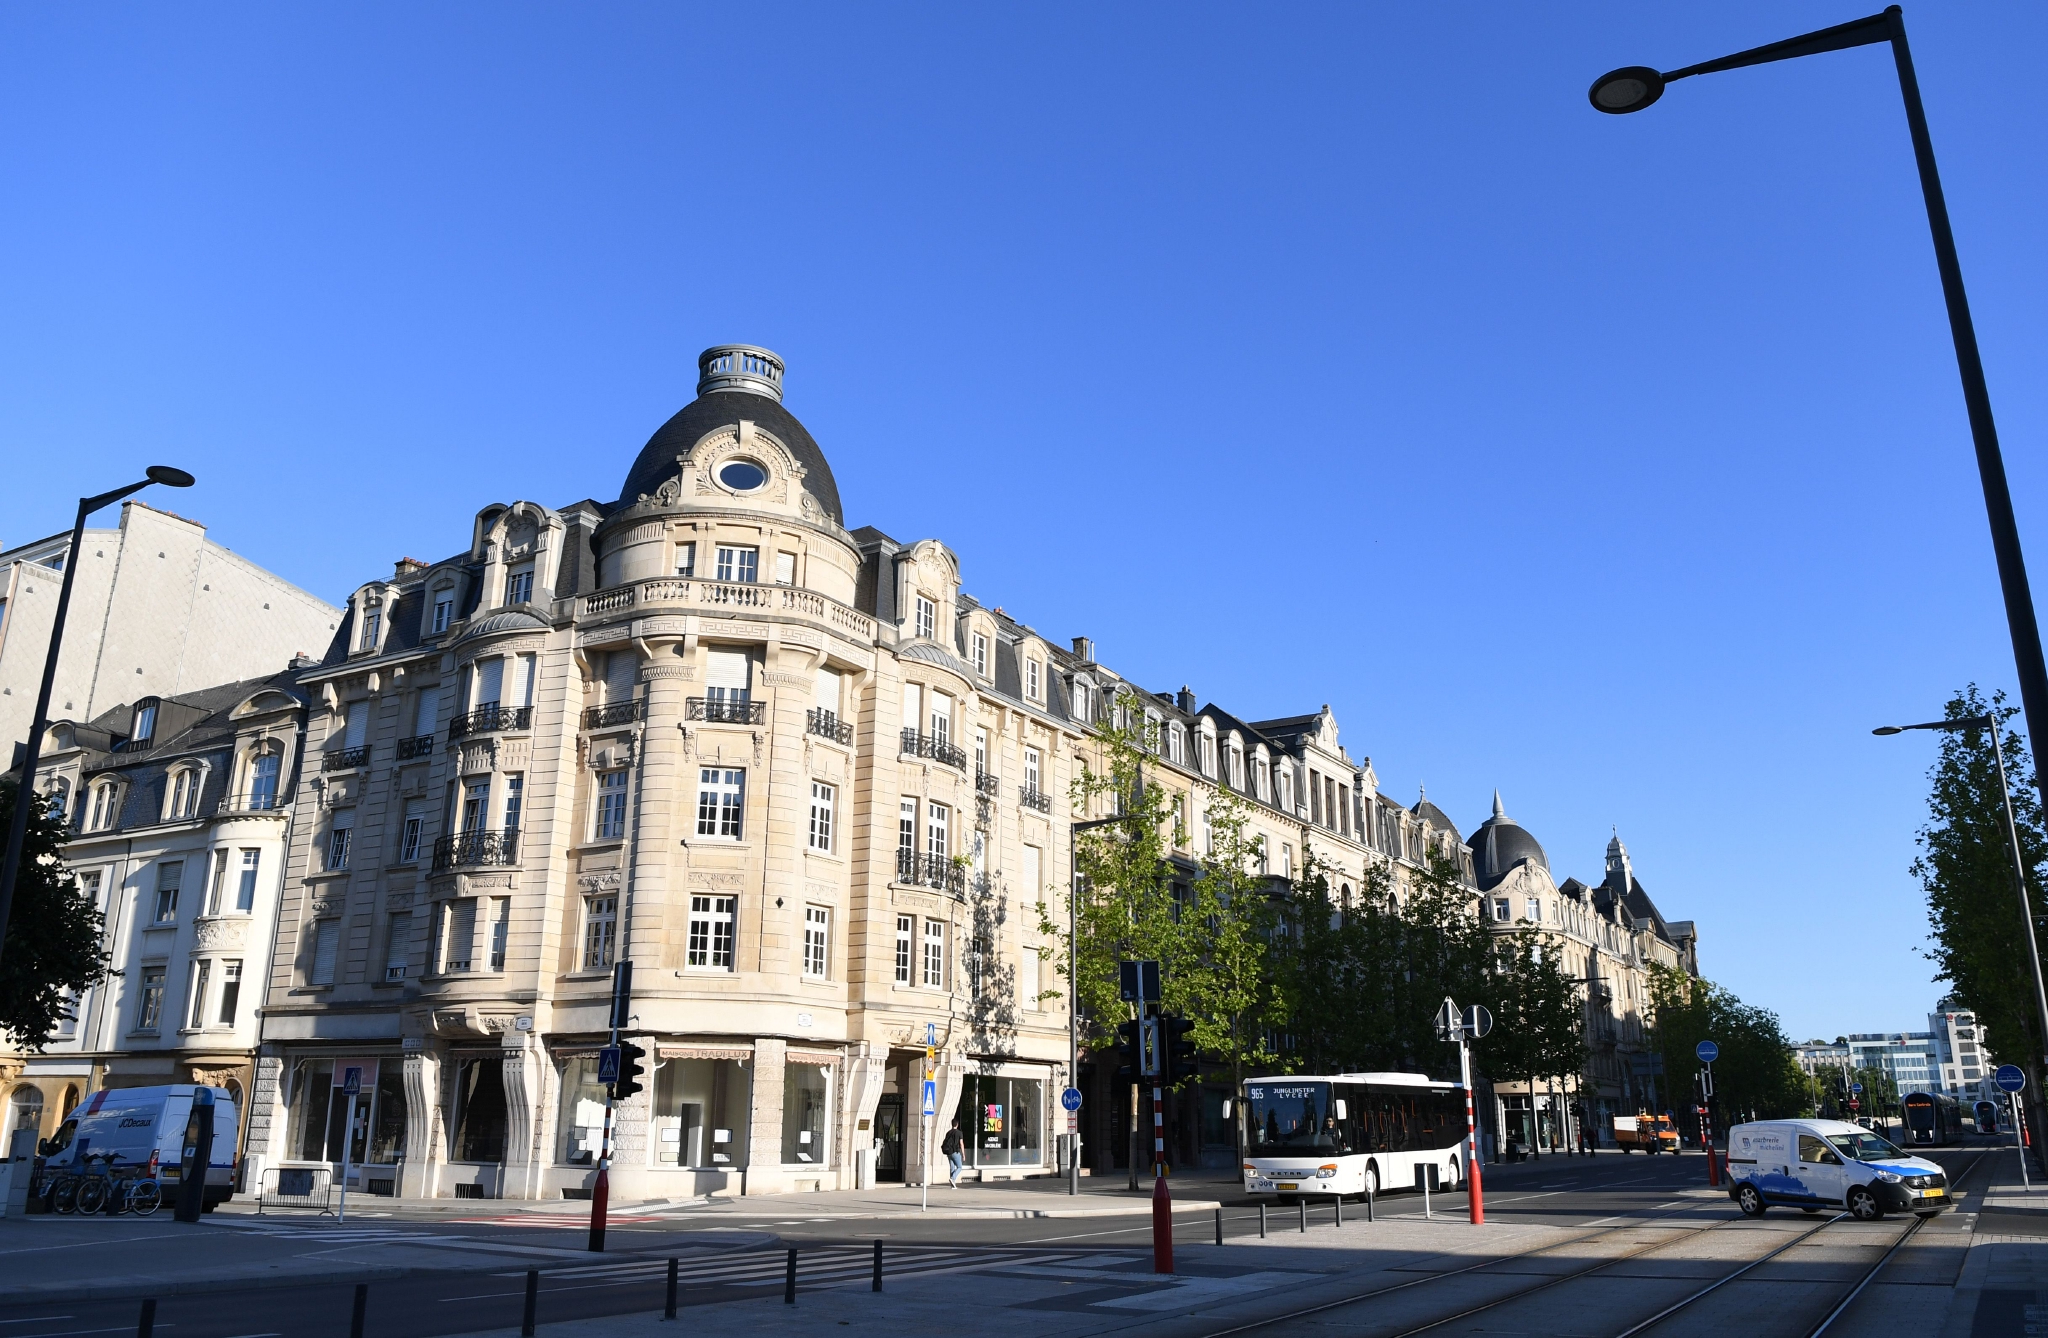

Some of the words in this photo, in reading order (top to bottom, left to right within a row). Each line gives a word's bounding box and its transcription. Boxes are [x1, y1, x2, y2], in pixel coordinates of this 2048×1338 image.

[695, 1050, 747, 1058] TRADI-LUX
[1251, 1088, 1264, 1099] 965
[118, 1118, 152, 1128] JCDecaux
